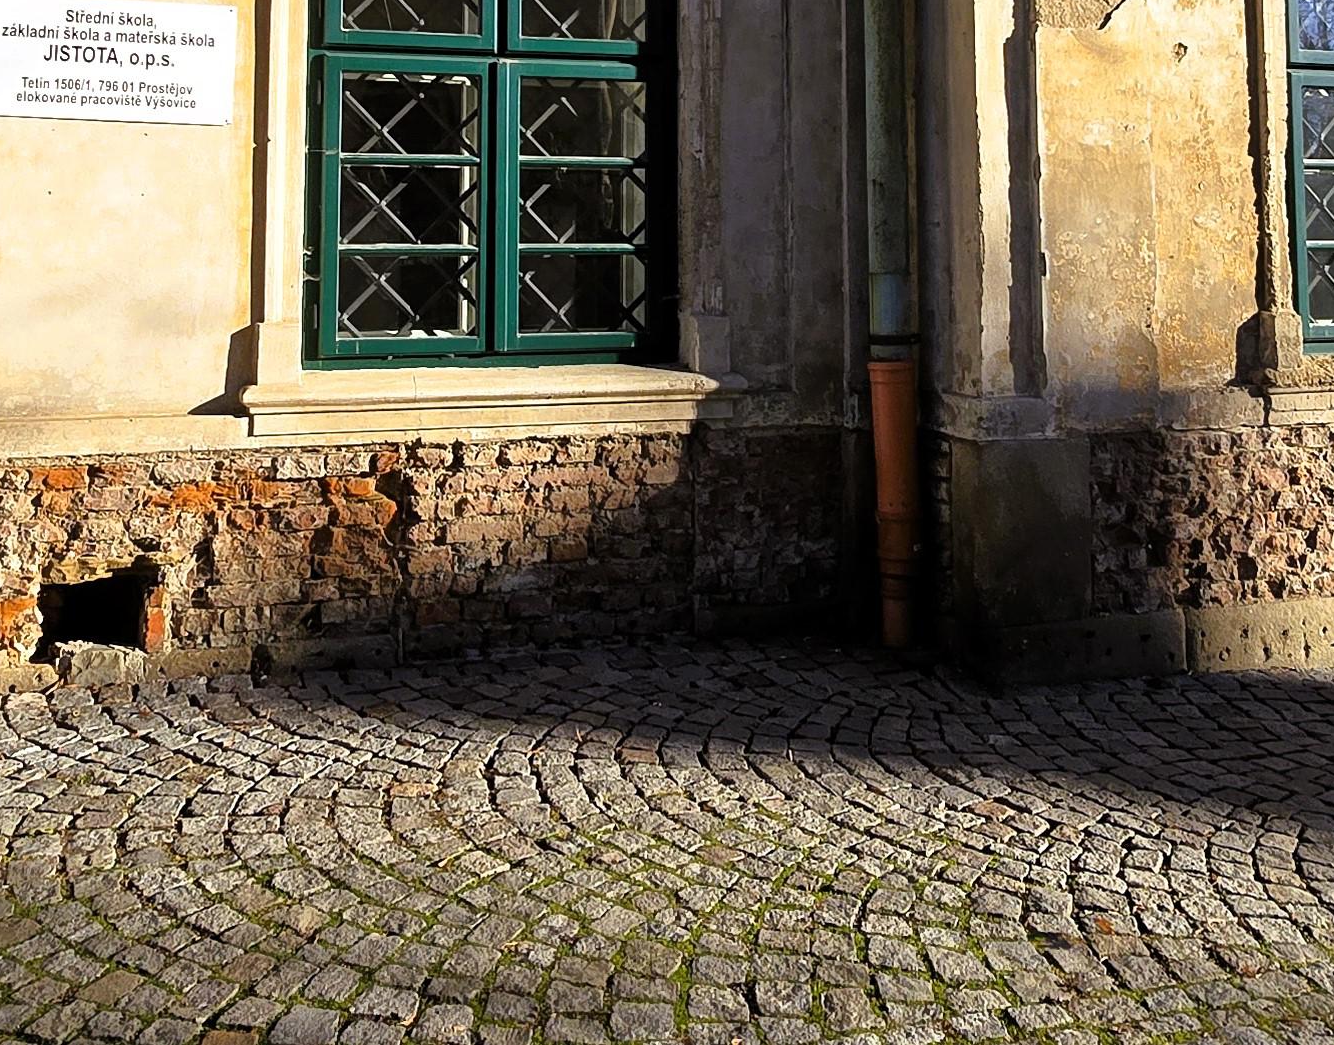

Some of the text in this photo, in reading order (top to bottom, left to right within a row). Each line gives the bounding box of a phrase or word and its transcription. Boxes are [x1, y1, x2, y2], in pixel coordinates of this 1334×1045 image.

[65, 9, 157, 29] Střední škola,
[1, 23, 215, 47] základní škola a mateřská škola
[43, 44, 175, 70] JISTOTA, o.p.s.
[54, 78, 95, 93] 1506/1,
[98, 79, 119, 92] 796
[122, 80, 134, 93] 01
[138, 81, 193, 97] Prostějov
[16, 90, 196, 110] elokované pracoviště Výšovice
